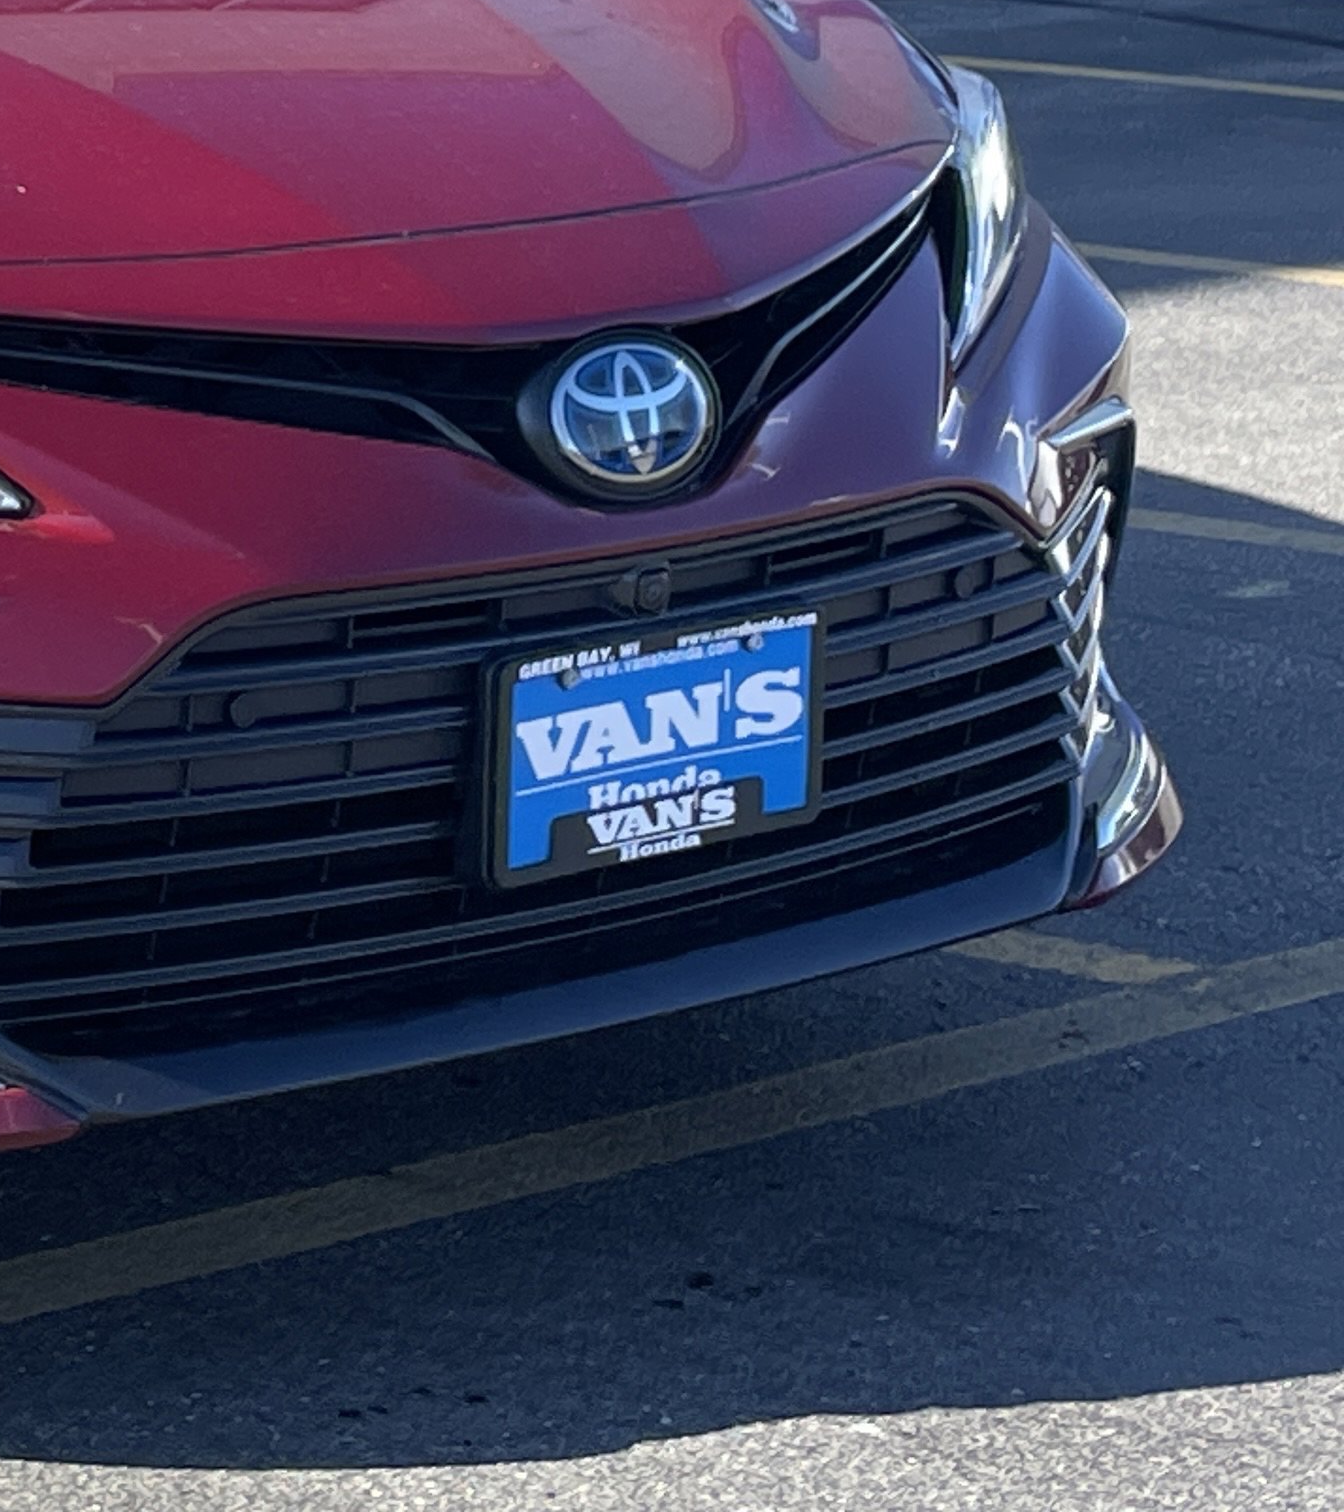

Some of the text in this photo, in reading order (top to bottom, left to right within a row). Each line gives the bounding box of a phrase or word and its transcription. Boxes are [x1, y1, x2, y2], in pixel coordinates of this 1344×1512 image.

[518, 653, 574, 681] GREEN
[516, 667, 803, 781] VAN'S
[588, 765, 721, 810] Honda
[587, 786, 737, 846] VAN'S
[620, 832, 701, 862] Honda
